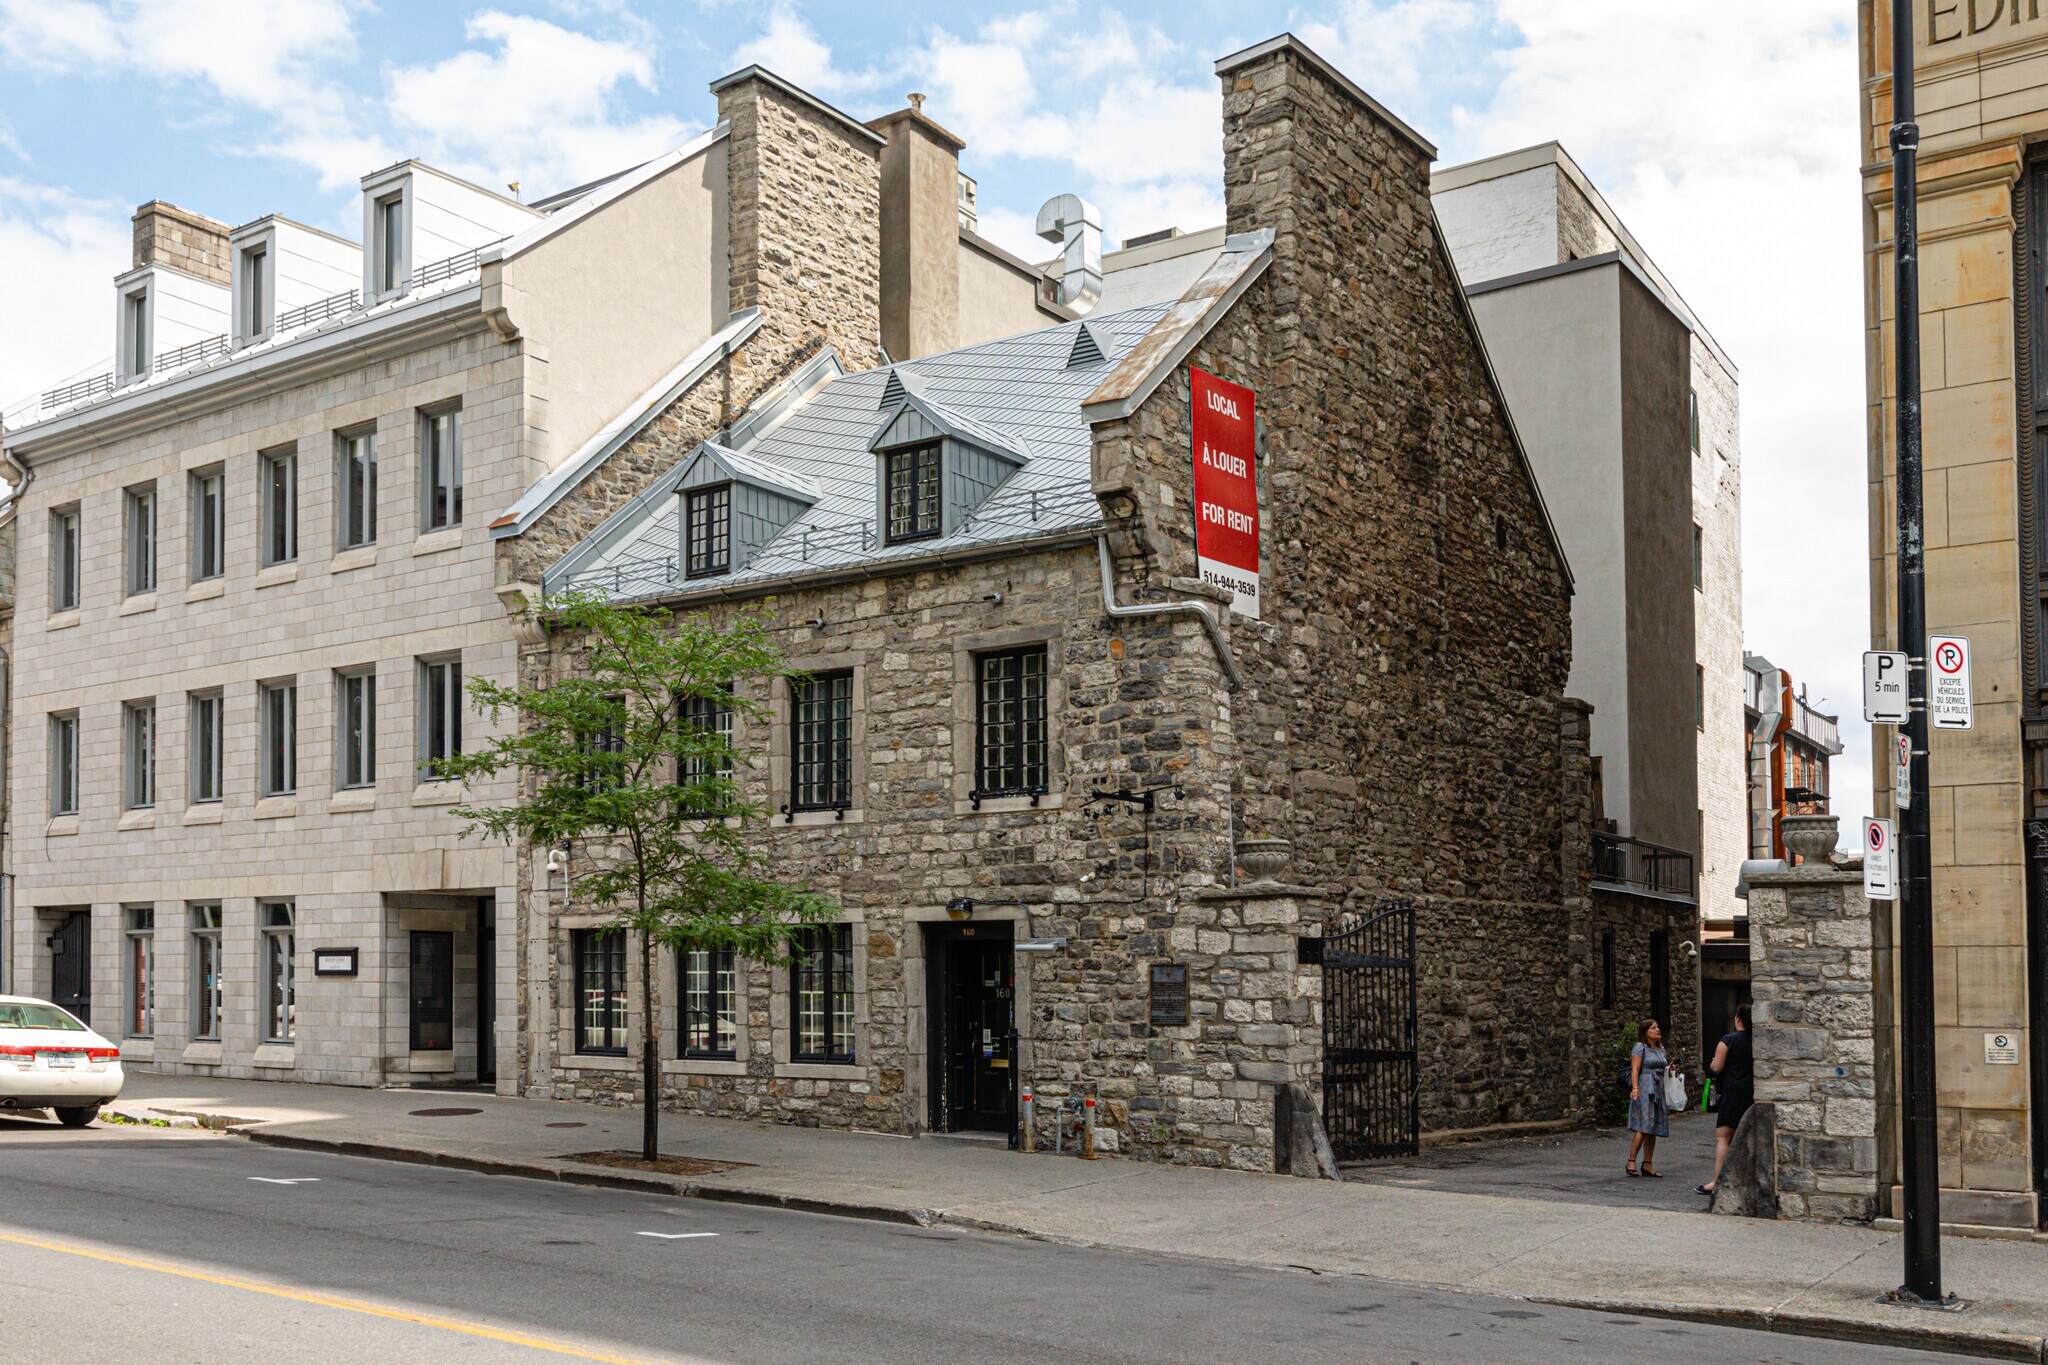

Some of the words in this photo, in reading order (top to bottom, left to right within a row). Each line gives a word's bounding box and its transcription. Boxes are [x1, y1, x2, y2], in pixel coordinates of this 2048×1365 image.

[1207, 390, 1241, 421] LOCAL
[1202, 442, 1212, 466] À
[1213, 451, 1247, 479] LOUER
[1202, 502, 1225, 526] FOR
[1227, 509, 1254, 535] RENT
[1203, 570, 1256, 597] 514-944-3539
[1877, 655, 1894, 680] P
[1874, 681, 1882, 693] 5
[1883, 681, 1900, 693] min
[1936, 696, 1944, 704] DU
[1945, 696, 1966, 705] SERVICE
[1934, 705, 1942, 713] DE
[1943, 706, 1950, 714] LA
[1951, 706, 1969, 715] POLICE
[962, 928, 975, 936] 160
[995, 987, 1011, 999] 160
